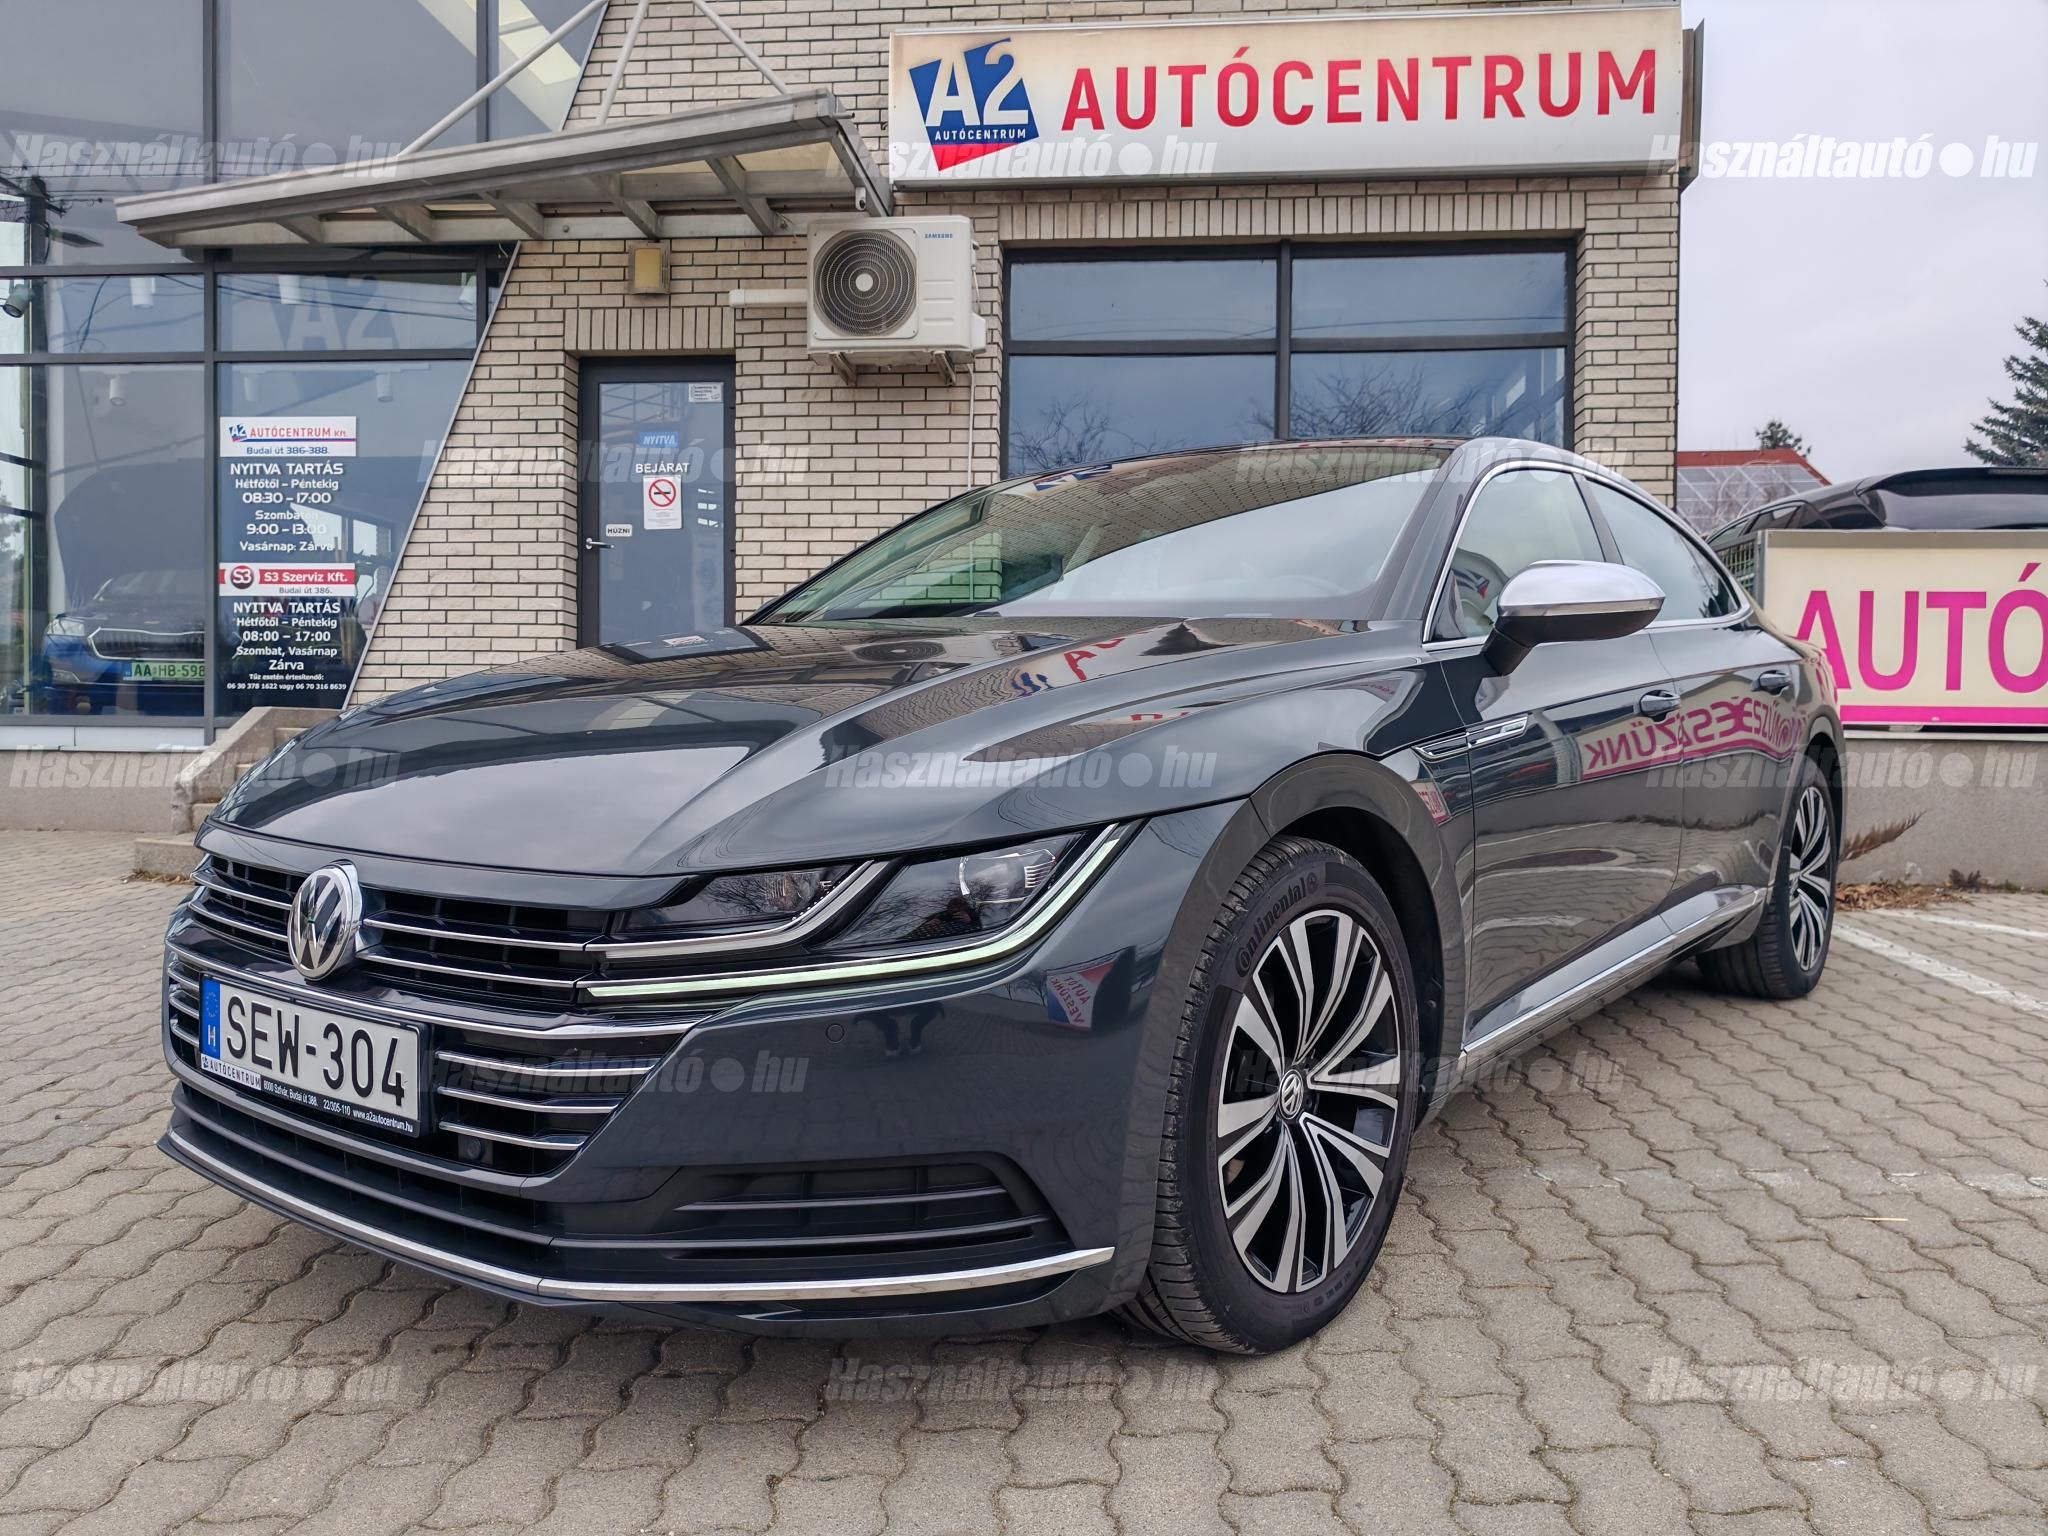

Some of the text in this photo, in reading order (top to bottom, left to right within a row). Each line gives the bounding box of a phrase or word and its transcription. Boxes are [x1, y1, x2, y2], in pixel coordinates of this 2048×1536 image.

[925, 38, 1029, 127] A2
[1062, 45, 1657, 131] AUTÓCENTRUM
[934, 127, 1027, 141] AUTÓCENTRUM
[250, 427, 331, 438] AUTÓCENTRUM
[246, 446, 273, 455] Budai
[275, 446, 284, 455] út
[230, 460, 344, 475] NYITVA TARTÁS
[635, 461, 690, 474] BEJÁRAT
[235, 478, 280, 489] Hétfőtől
[291, 478, 339, 492] Péntekig
[242, 492, 283, 504] 08:30
[296, 492, 332, 504] 17:00
[246, 524, 279, 535] 9:00
[293, 524, 327, 535] 13:00
[607, 526, 631, 534] HÚZNI
[240, 540, 335, 553] Vasárnap: Zárva
[232, 569, 348, 584] S3 S3 Szerviz Kft.
[279, 586, 302, 594] Budai
[304, 586, 312, 594] út
[234, 599, 341, 614] NYITVA TARTÁS
[236, 617, 279, 627] Hétfőtől
[291, 617, 338, 629] Péntekig
[1796, 562, 2048, 694] AUTÓ
[242, 631, 279, 642] 08:00
[295, 631, 331, 642] 17:00
[237, 646, 338, 658] Szombat, Vasárnap
[134, 663, 152, 677] AA
[269, 659, 304, 671] Zárva
[226, 996, 405, 1107] SEW-304
